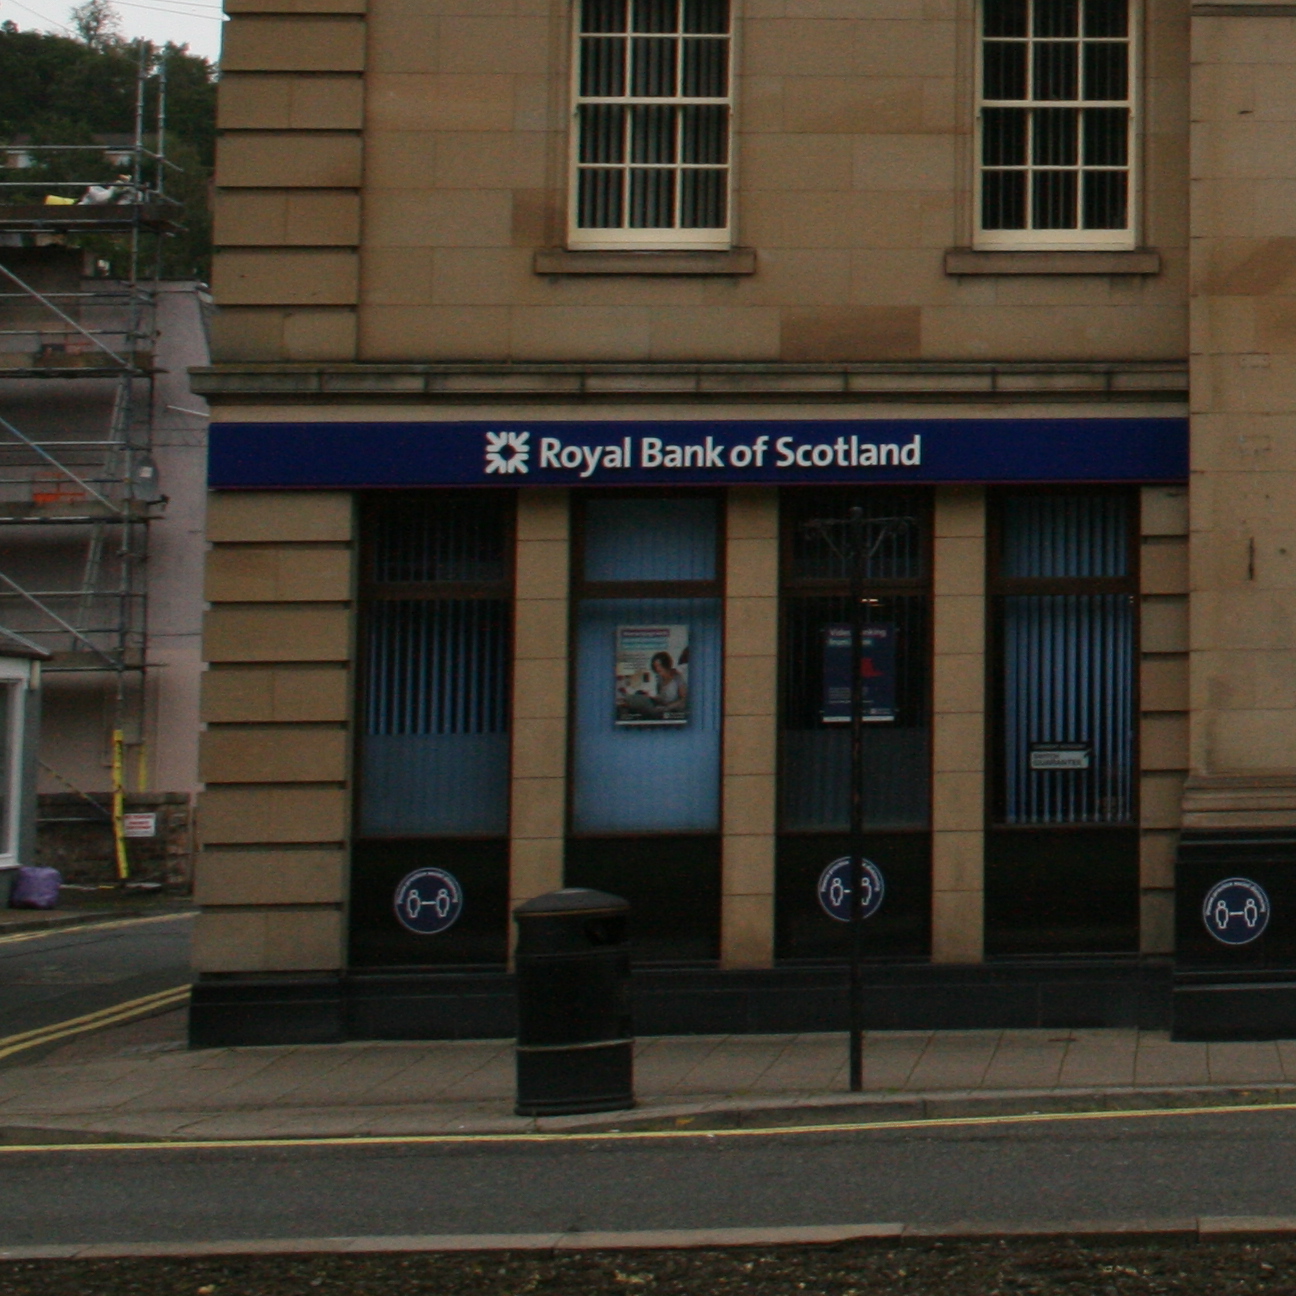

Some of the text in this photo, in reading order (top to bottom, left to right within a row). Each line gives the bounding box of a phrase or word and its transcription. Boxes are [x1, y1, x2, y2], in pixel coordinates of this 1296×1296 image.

[539, 434, 921, 477] Royal Bank of Scotland
